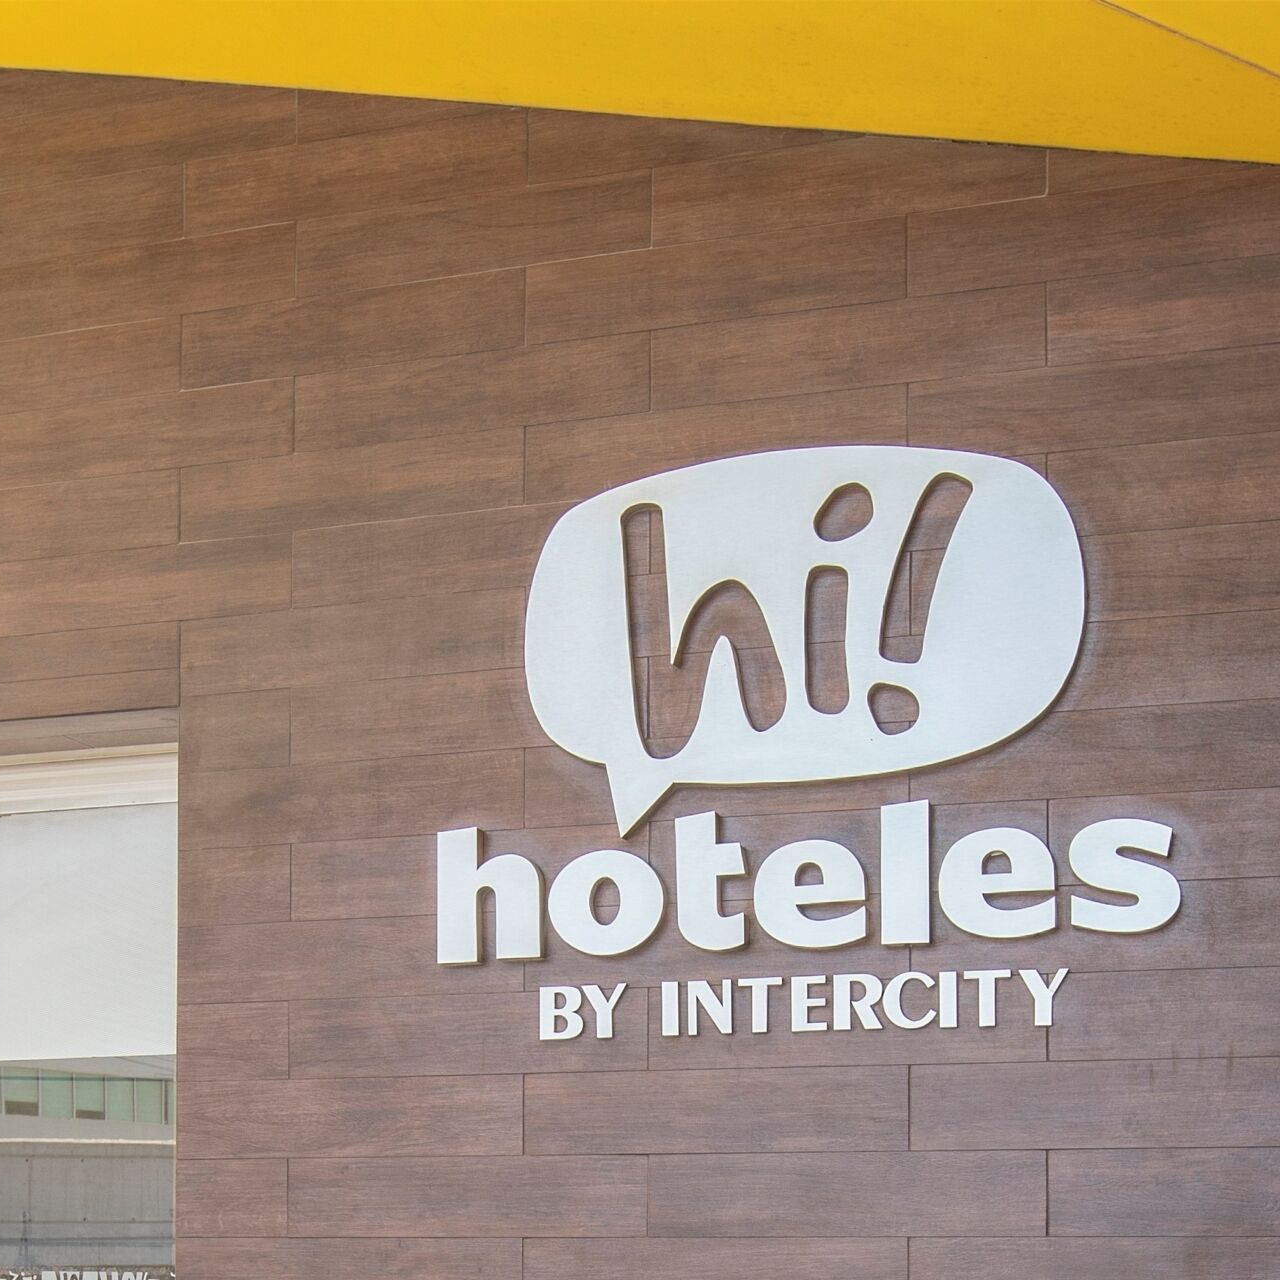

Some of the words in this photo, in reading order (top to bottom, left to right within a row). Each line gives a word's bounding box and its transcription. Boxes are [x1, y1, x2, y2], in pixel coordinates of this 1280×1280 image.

[620, 471, 974, 759] hi!
[436, 799, 1183, 965] hoteles
[539, 982, 628, 1041] BY
[660, 967, 1070, 1038] INTERCITY
